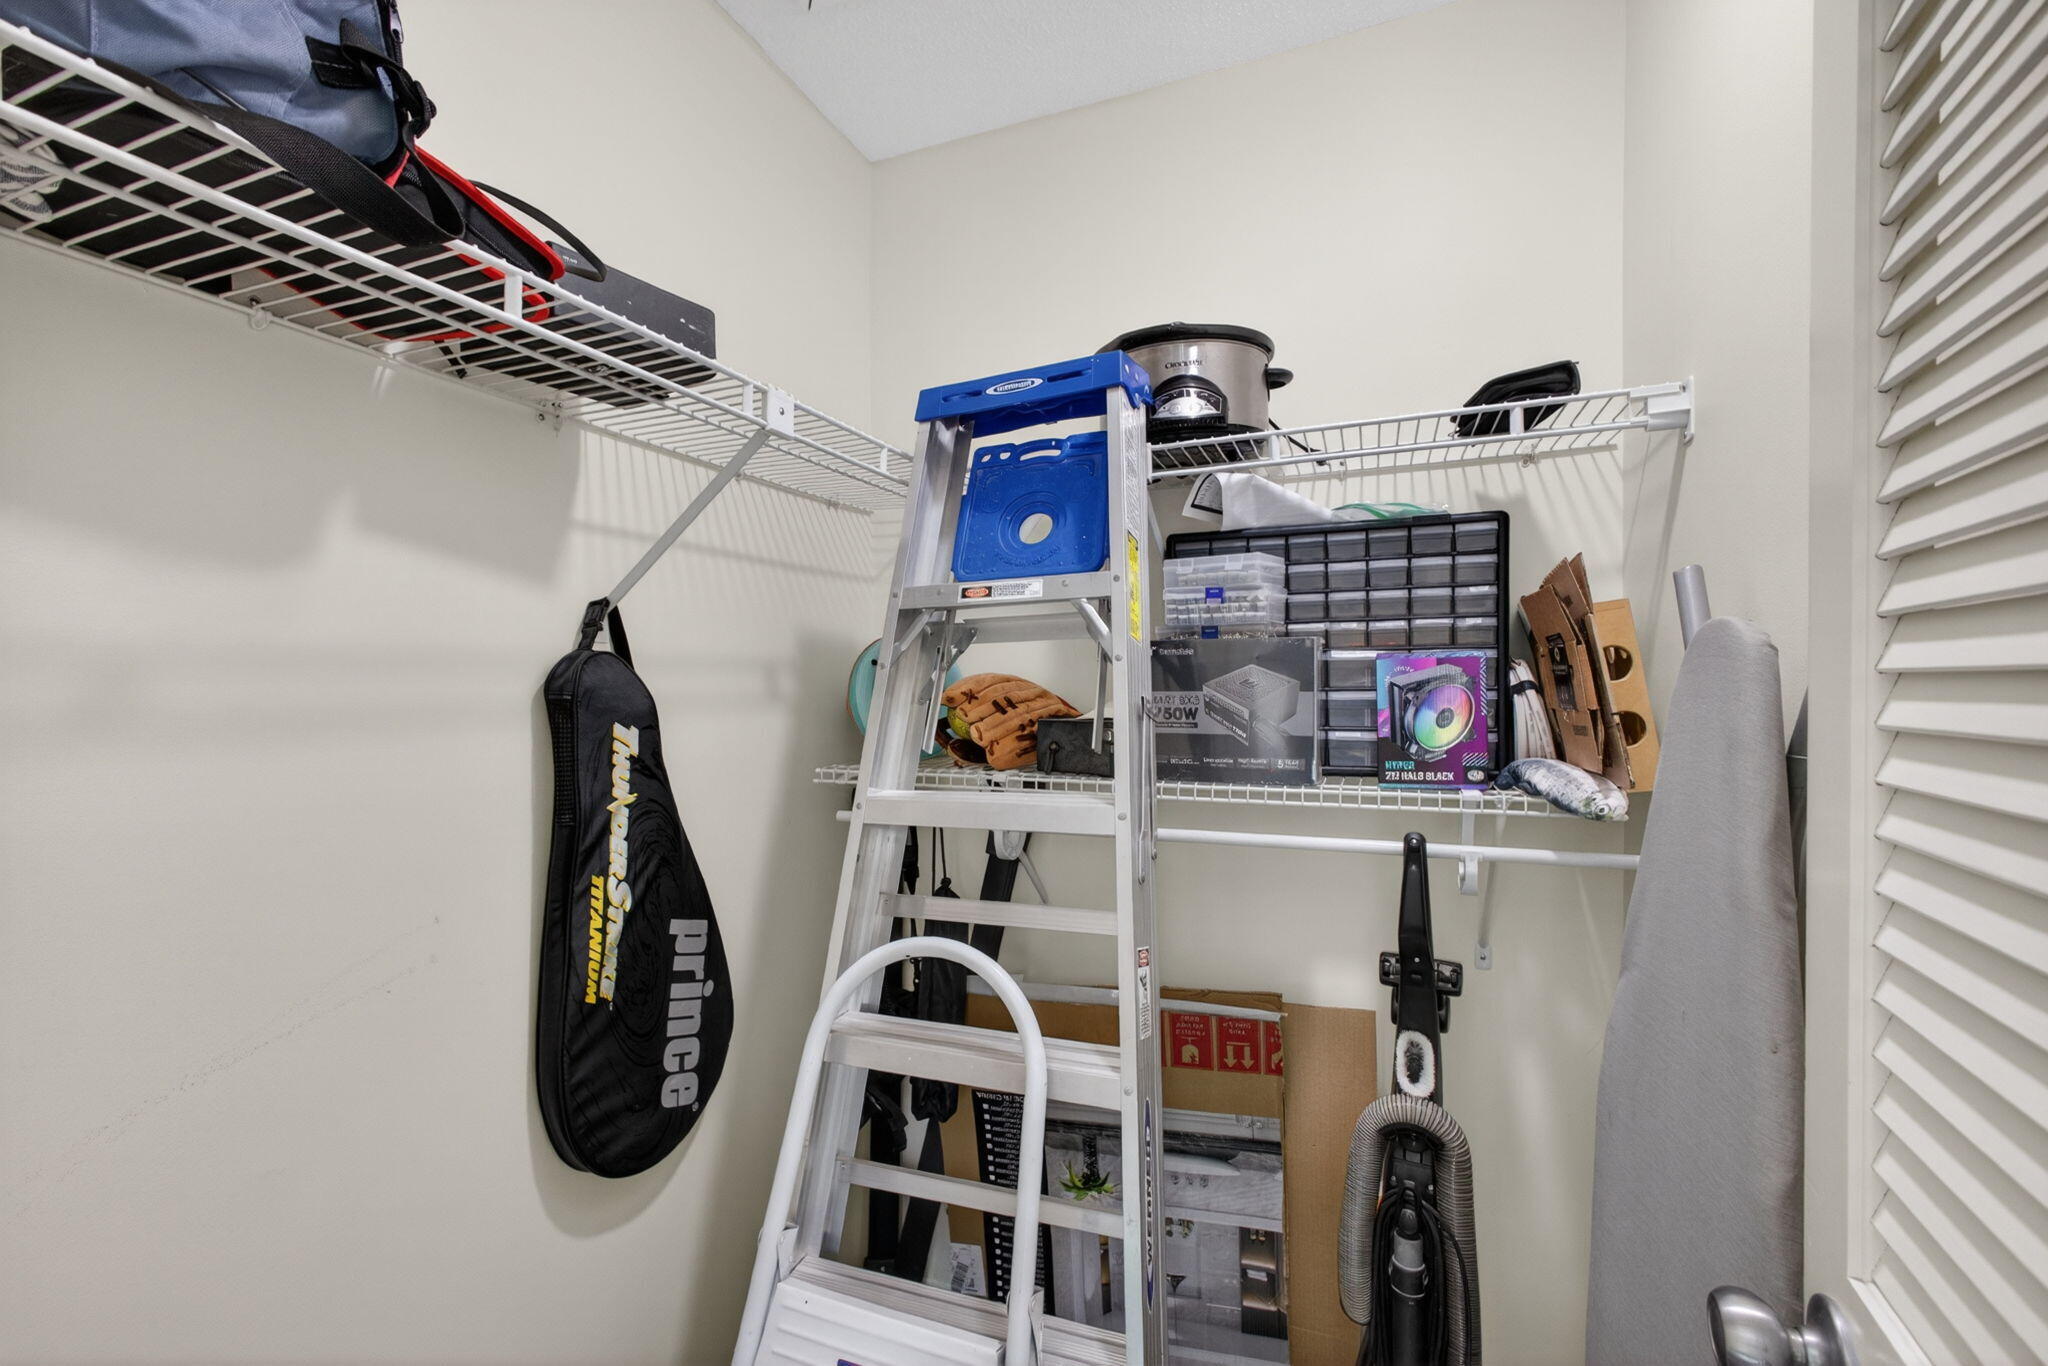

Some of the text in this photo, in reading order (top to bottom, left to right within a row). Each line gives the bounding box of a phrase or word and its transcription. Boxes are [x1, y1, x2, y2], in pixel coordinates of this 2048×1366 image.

[1425, 771, 1454, 781] BLACK
[583, 875, 605, 1004] TITANIUM
[660, 918, 713, 1110] prince
